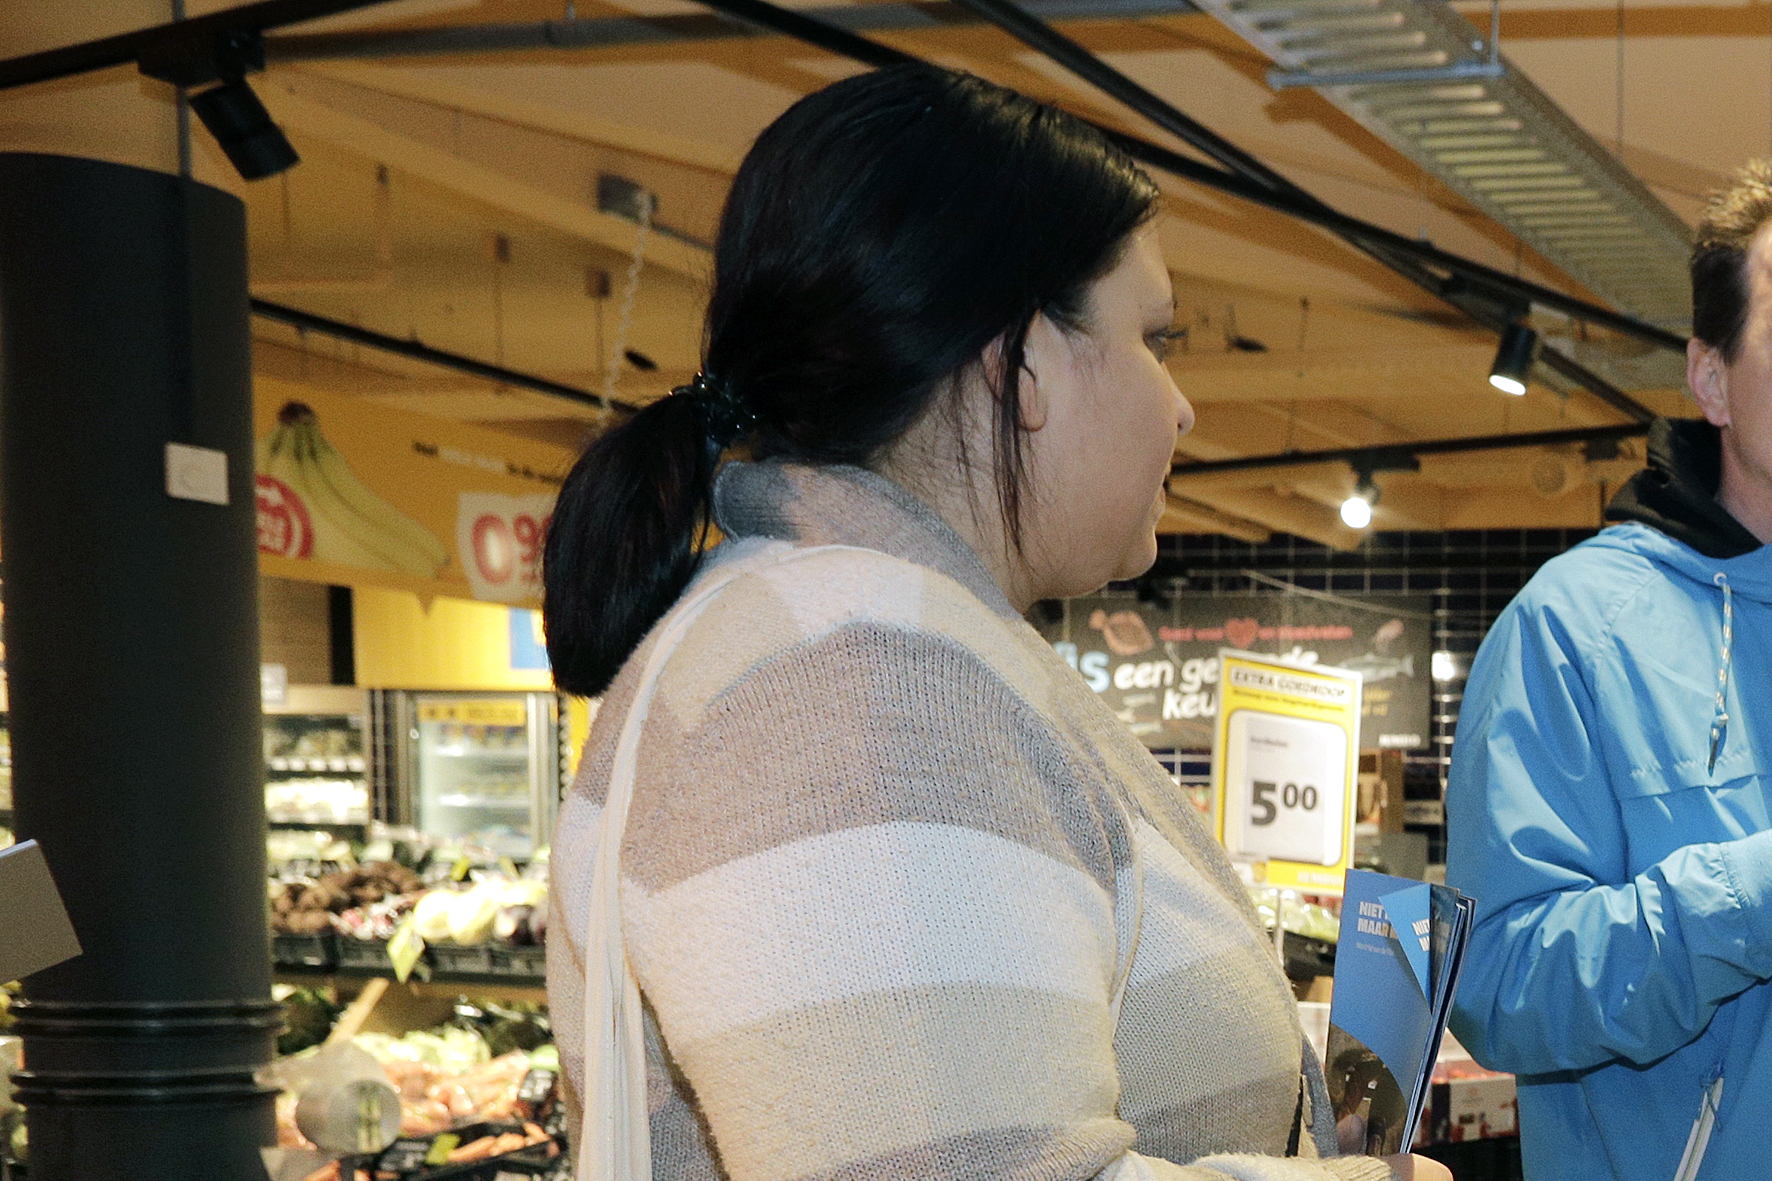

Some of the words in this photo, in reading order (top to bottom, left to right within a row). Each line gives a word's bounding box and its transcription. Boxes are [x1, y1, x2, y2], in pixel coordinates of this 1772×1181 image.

[1114, 660, 1174, 690] een
[1359, 901, 1384, 919] NIET
[1357, 918, 1390, 938] MAAR
